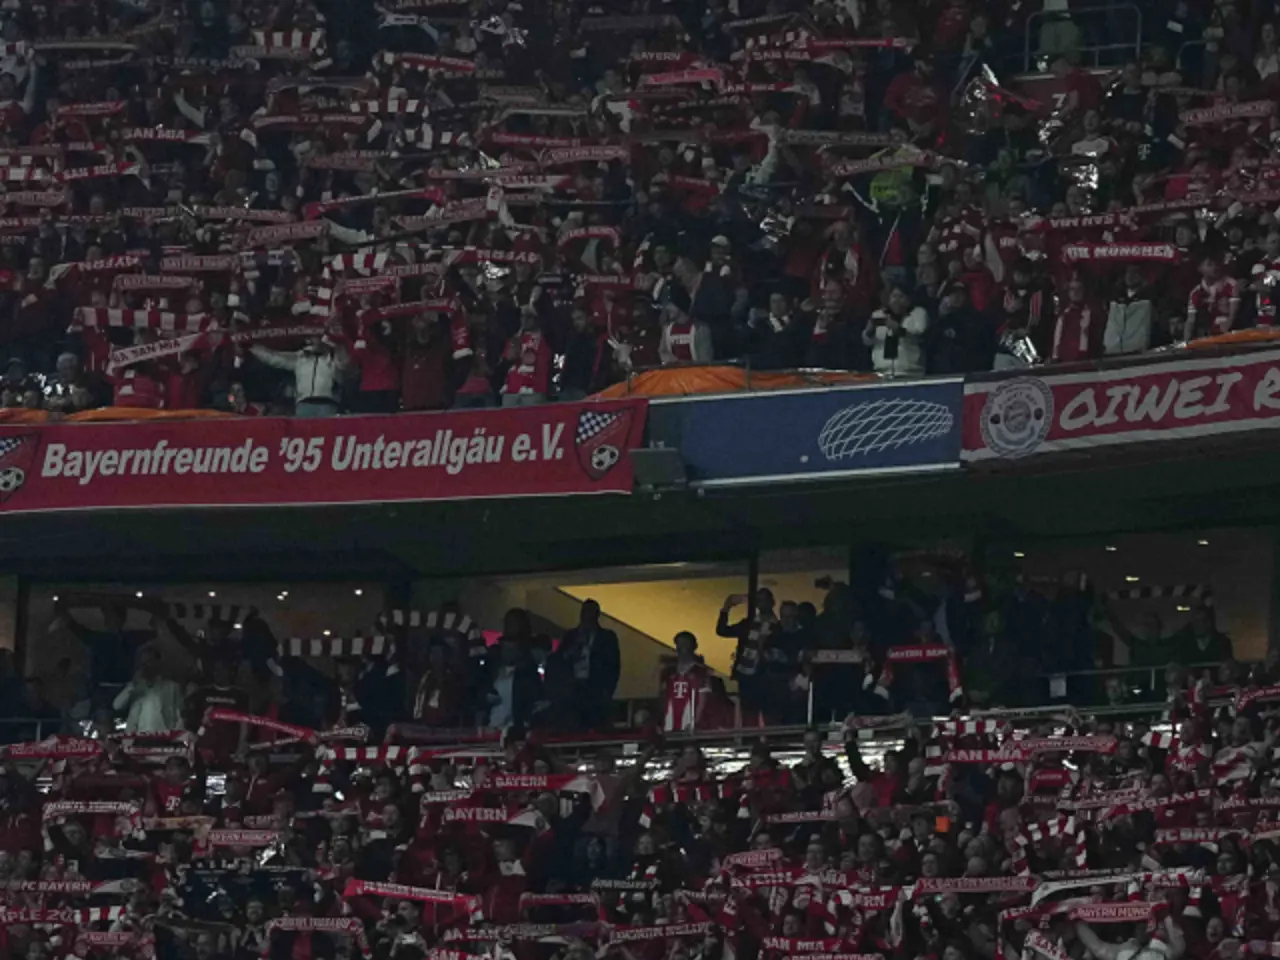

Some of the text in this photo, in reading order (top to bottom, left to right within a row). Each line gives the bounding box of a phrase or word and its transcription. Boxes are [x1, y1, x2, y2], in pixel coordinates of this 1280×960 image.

[42, 437, 268, 485] Bayernfreunde
[331, 429, 503, 475] Unterallgäu
[511, 423, 566, 462] e.V.
